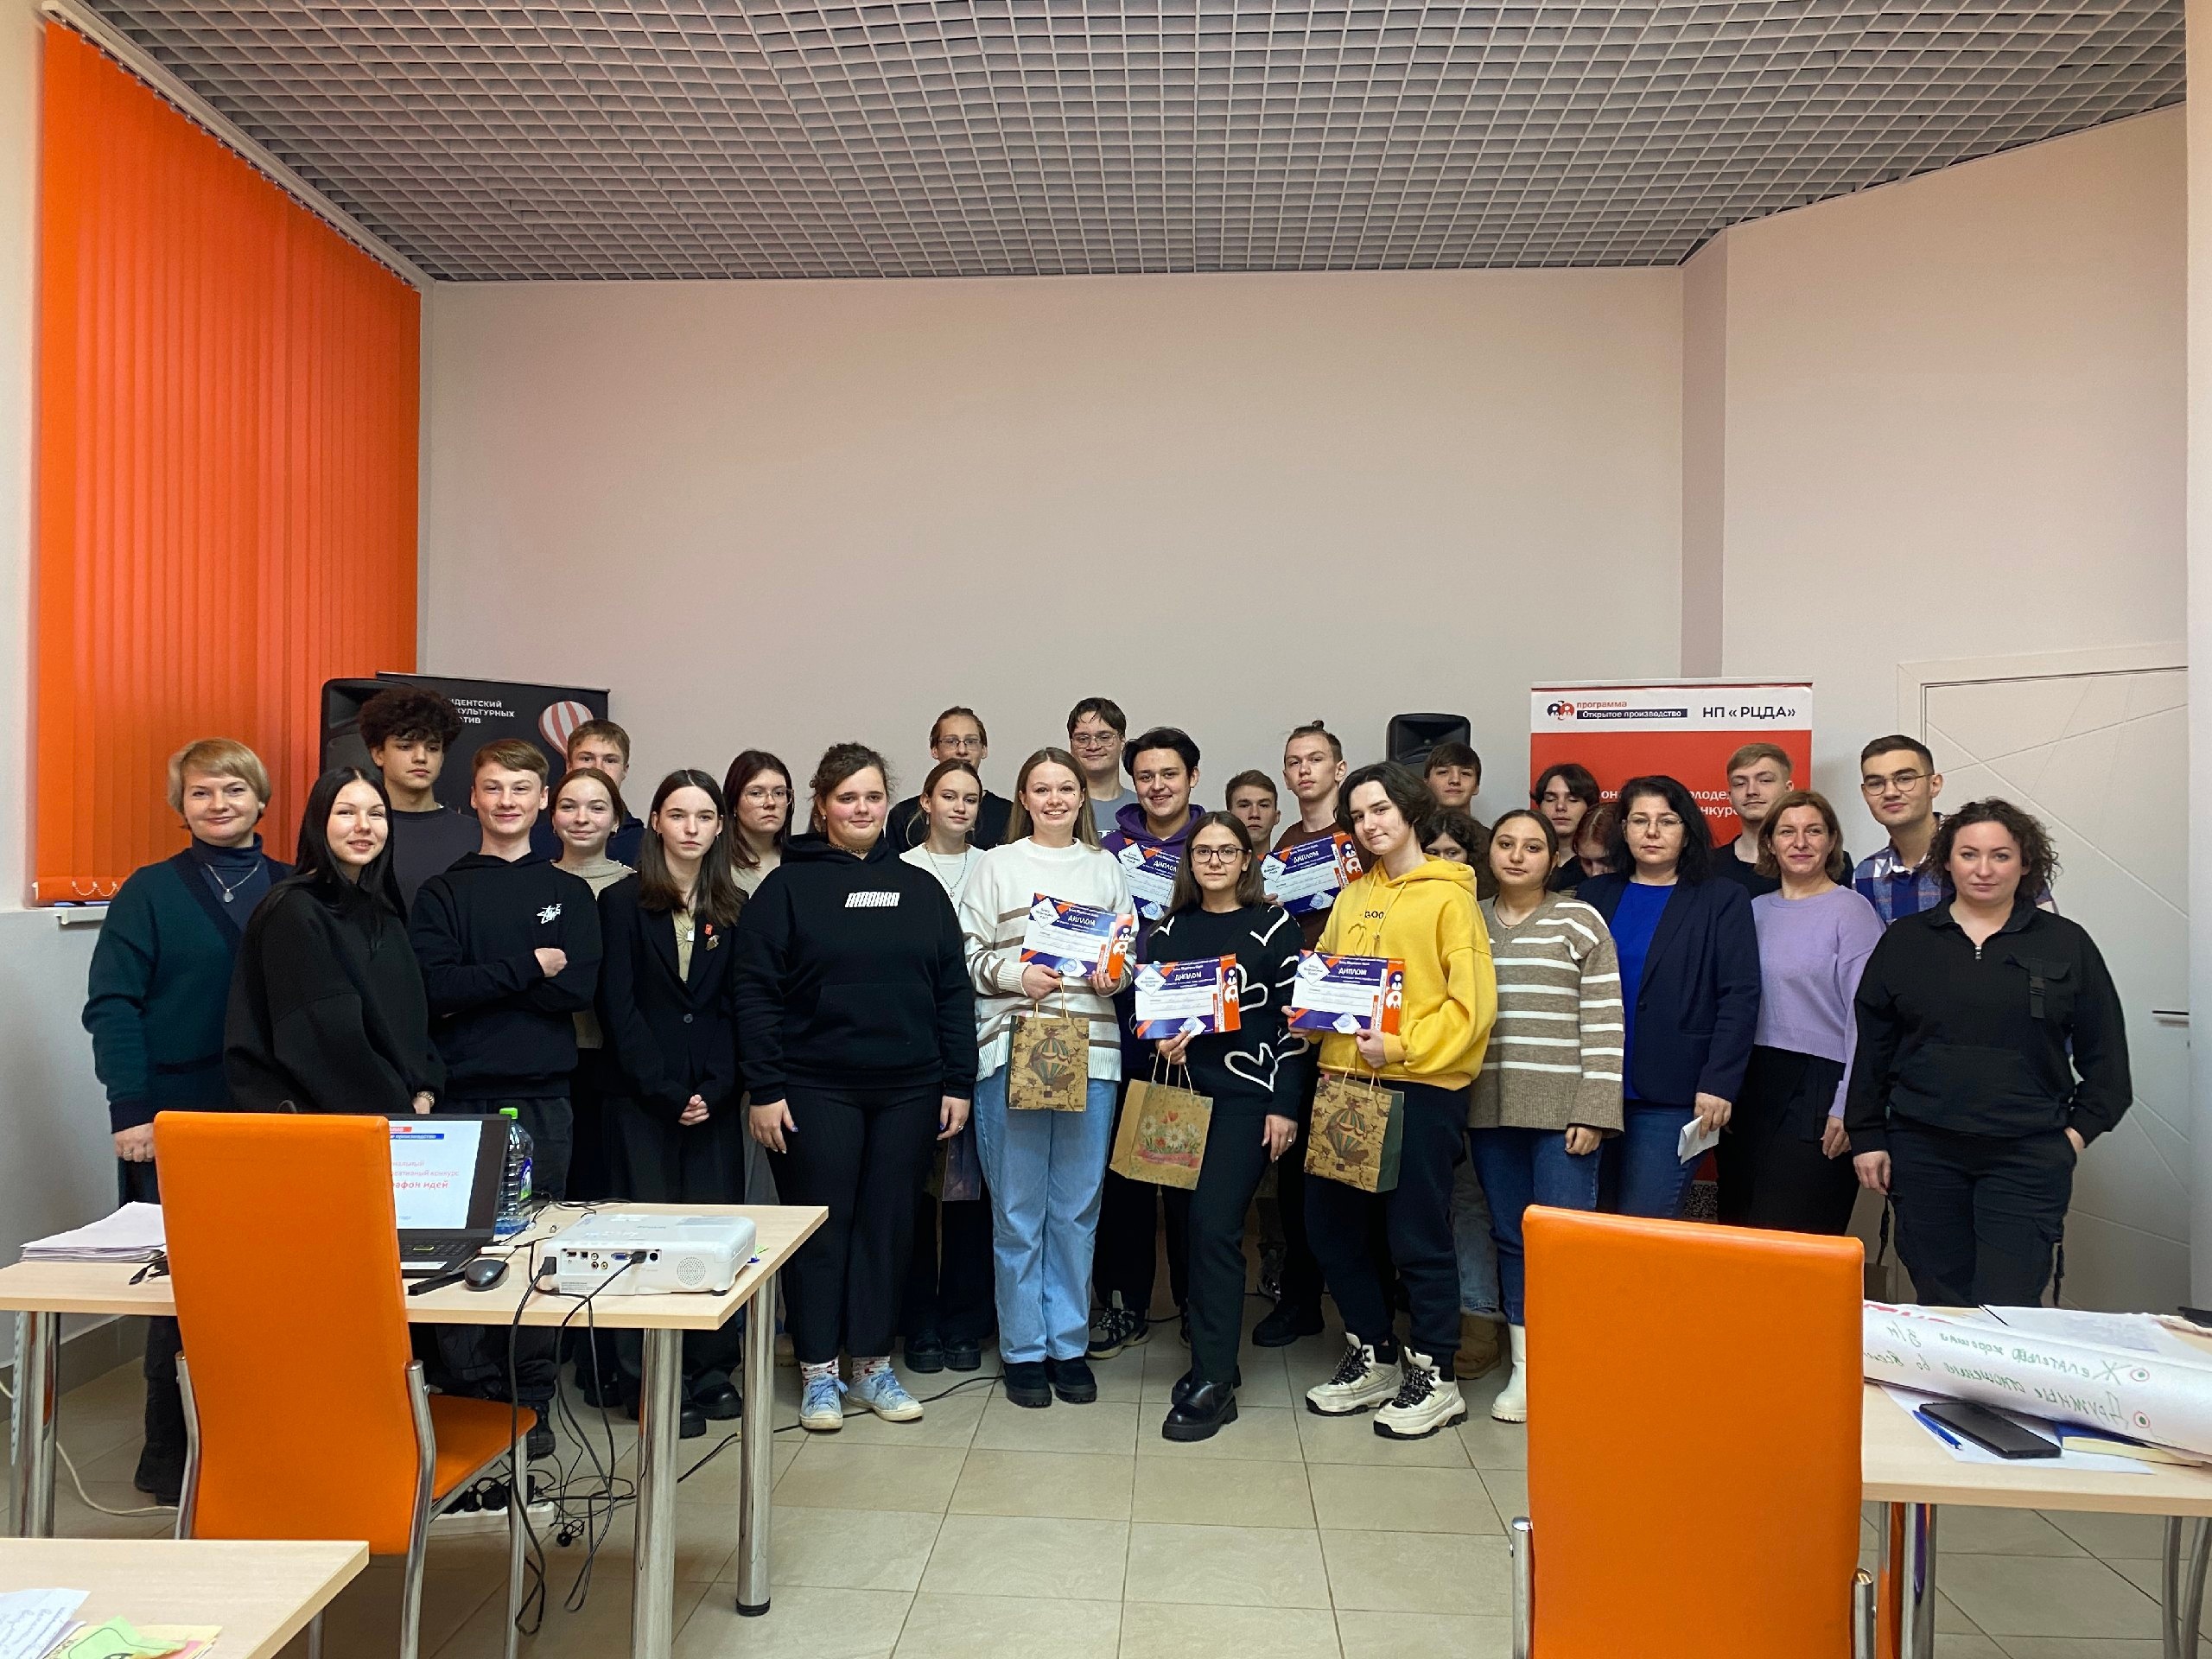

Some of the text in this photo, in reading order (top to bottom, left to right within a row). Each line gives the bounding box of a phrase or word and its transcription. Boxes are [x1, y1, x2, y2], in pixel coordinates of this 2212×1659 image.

[1576, 701, 1628, 709] программа
[1582, 710, 1682, 719] Открытое производство
[1702, 707, 1726, 717] НП
[1067, 914, 1096, 927] ДИПЛОМ
[1174, 970, 1202, 982] ДИПЛОМ
[1338, 967, 1367, 976] ДИПЛОМ
